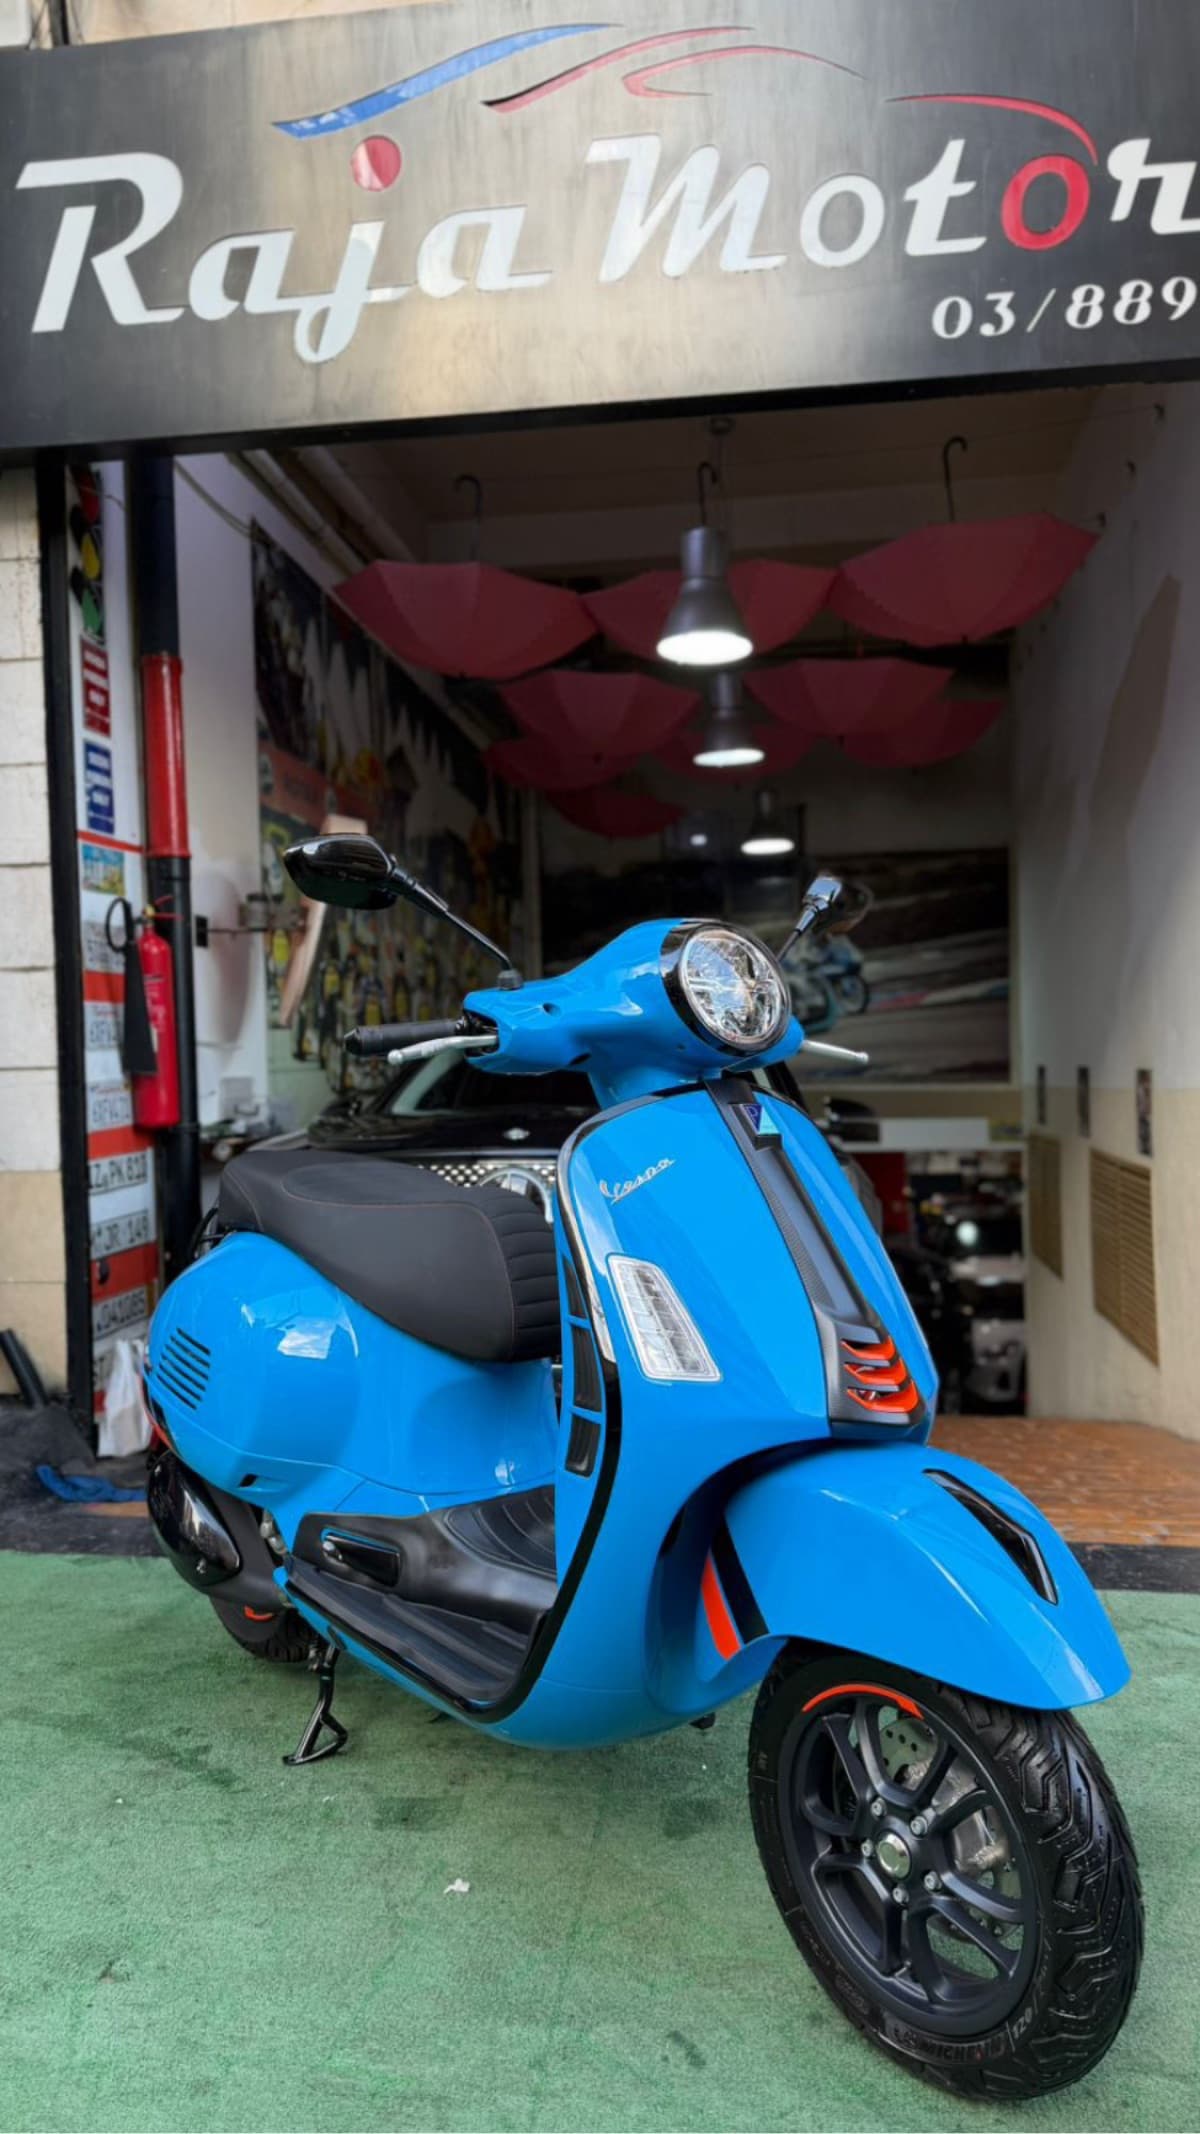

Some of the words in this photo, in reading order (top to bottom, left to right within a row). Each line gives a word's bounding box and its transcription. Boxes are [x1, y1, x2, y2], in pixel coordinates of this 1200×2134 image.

[15, 135, 552, 363] Raja
[583, 134, 1200, 283] Motor
[931, 276, 1198, 339] 03/889
[599, 1157, 677, 1206] Vespa
